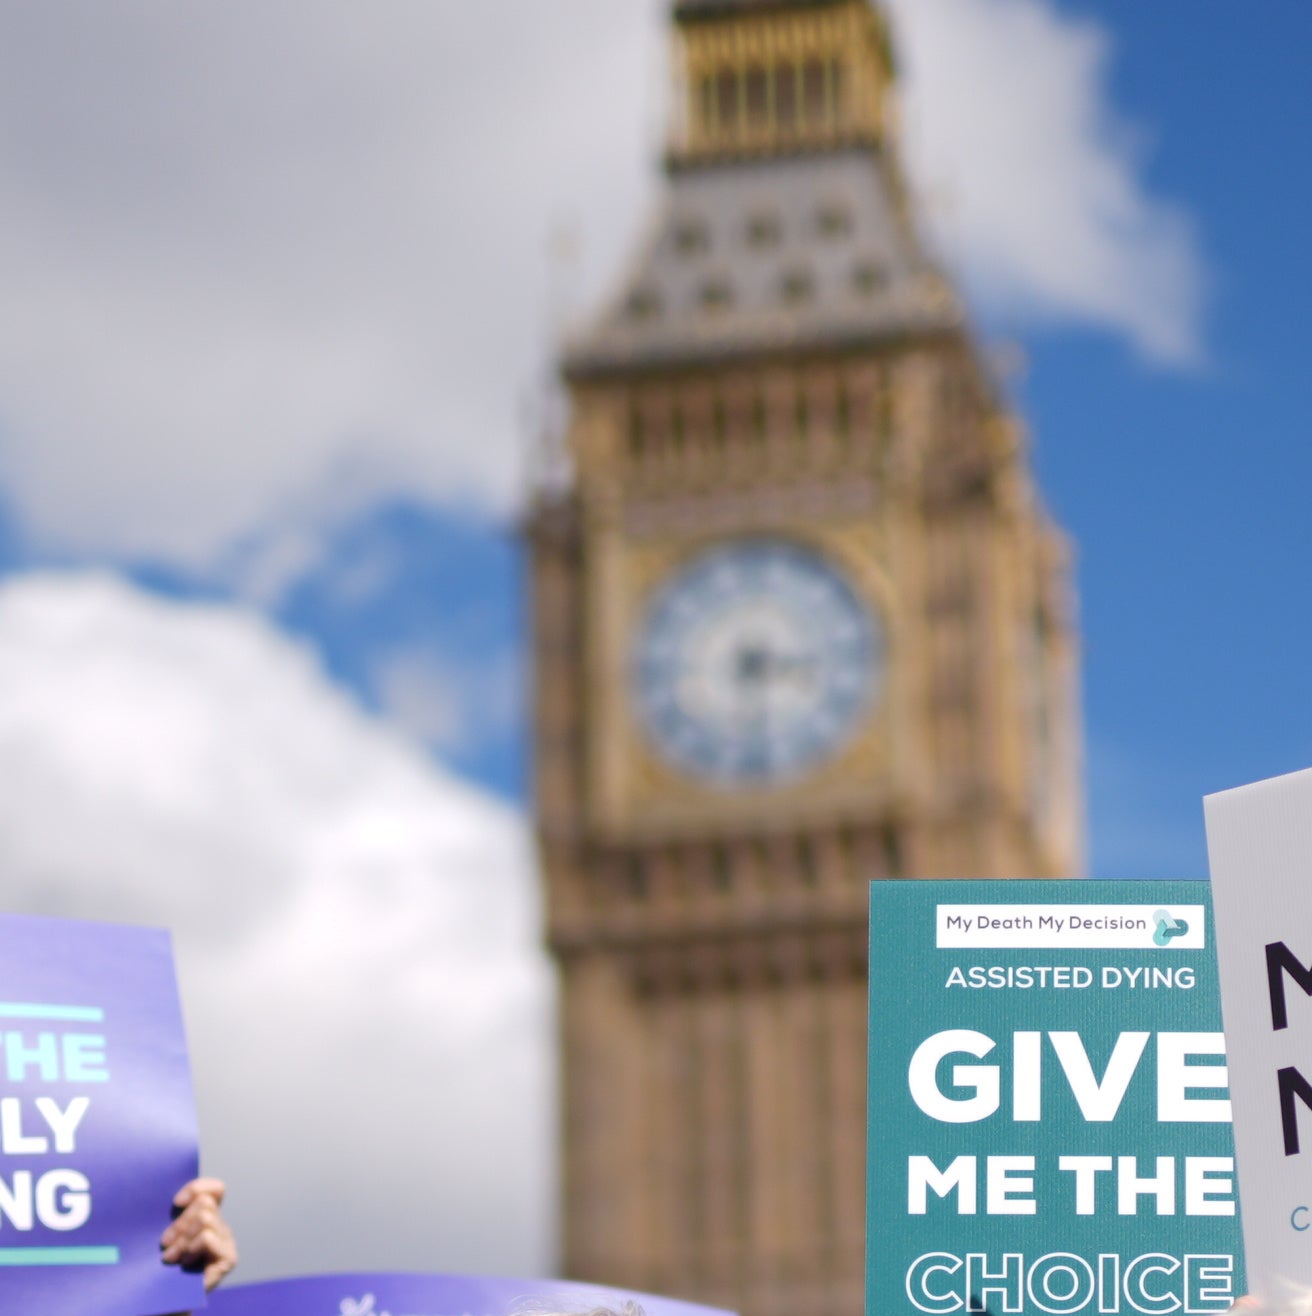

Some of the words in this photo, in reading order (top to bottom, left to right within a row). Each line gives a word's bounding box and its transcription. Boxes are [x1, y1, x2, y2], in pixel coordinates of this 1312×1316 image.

[946, 915, 972, 933] My
[977, 915, 1033, 930] Death
[1038, 915, 1066, 933] My
[1069, 915, 1147, 931] Decision
[945, 967, 1093, 989] ASSISTED
[1101, 967, 1196, 989] DYING
[908, 1029, 1232, 1123] GIVE
[907, 1155, 1037, 1215] ME
[1058, 1156, 1236, 1216] THE
[906, 1252, 1235, 1315] CHOICE
